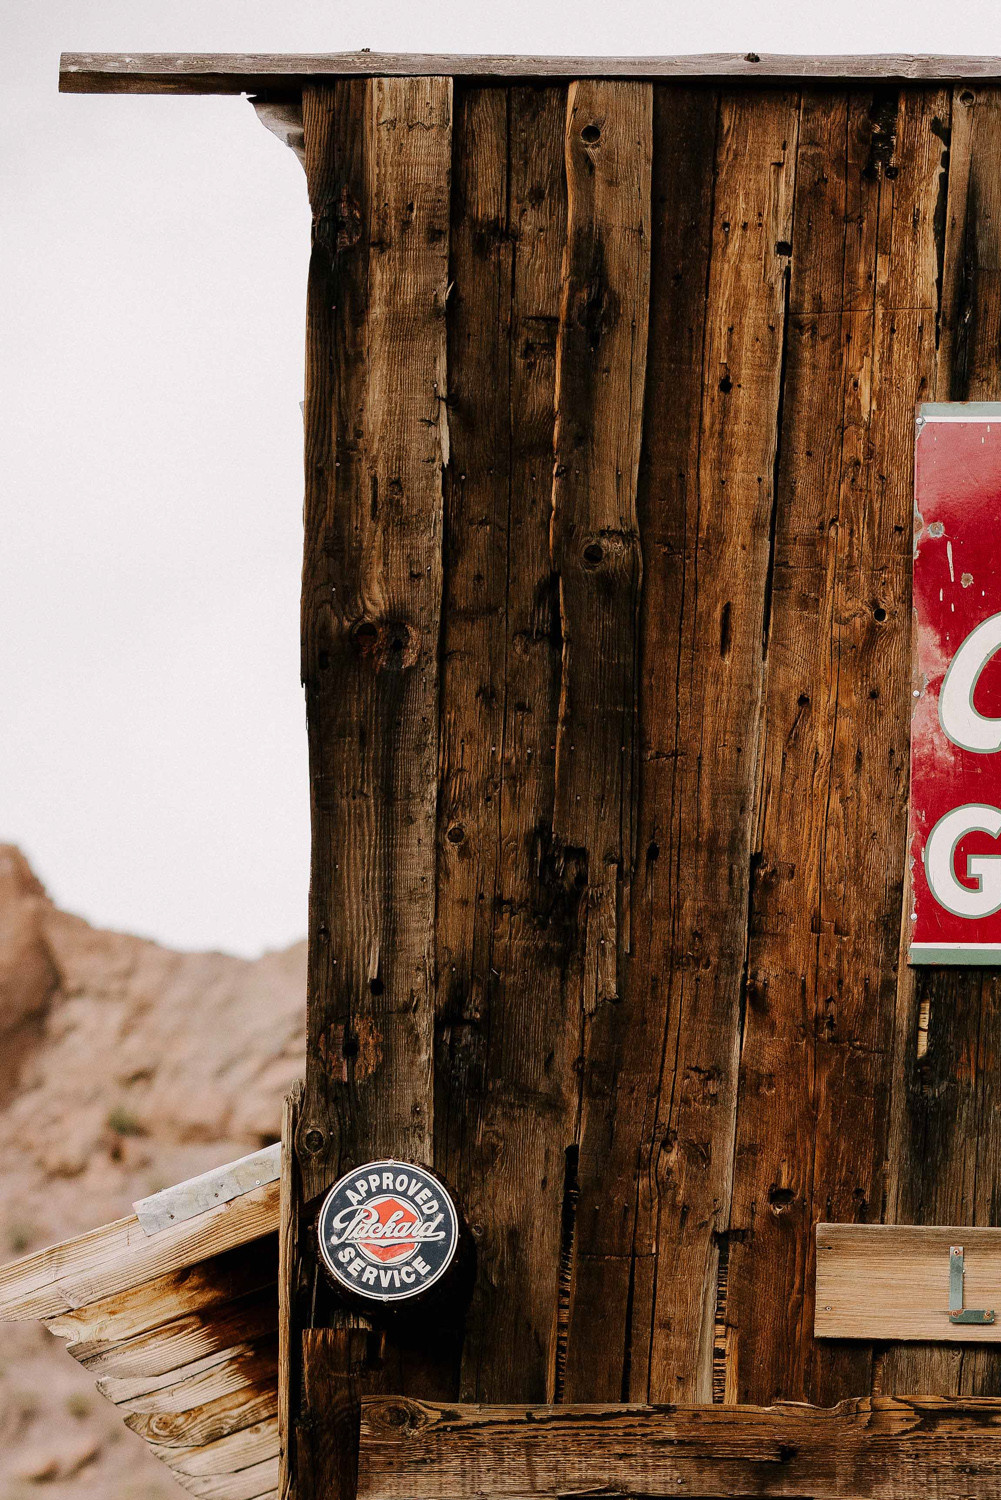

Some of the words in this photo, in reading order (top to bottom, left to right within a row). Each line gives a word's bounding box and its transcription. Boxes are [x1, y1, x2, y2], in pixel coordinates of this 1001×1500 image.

[345, 1172, 440, 1215] APPROVED
[330, 1204, 446, 1245] Packard
[338, 1246, 432, 1288] SERVICE
